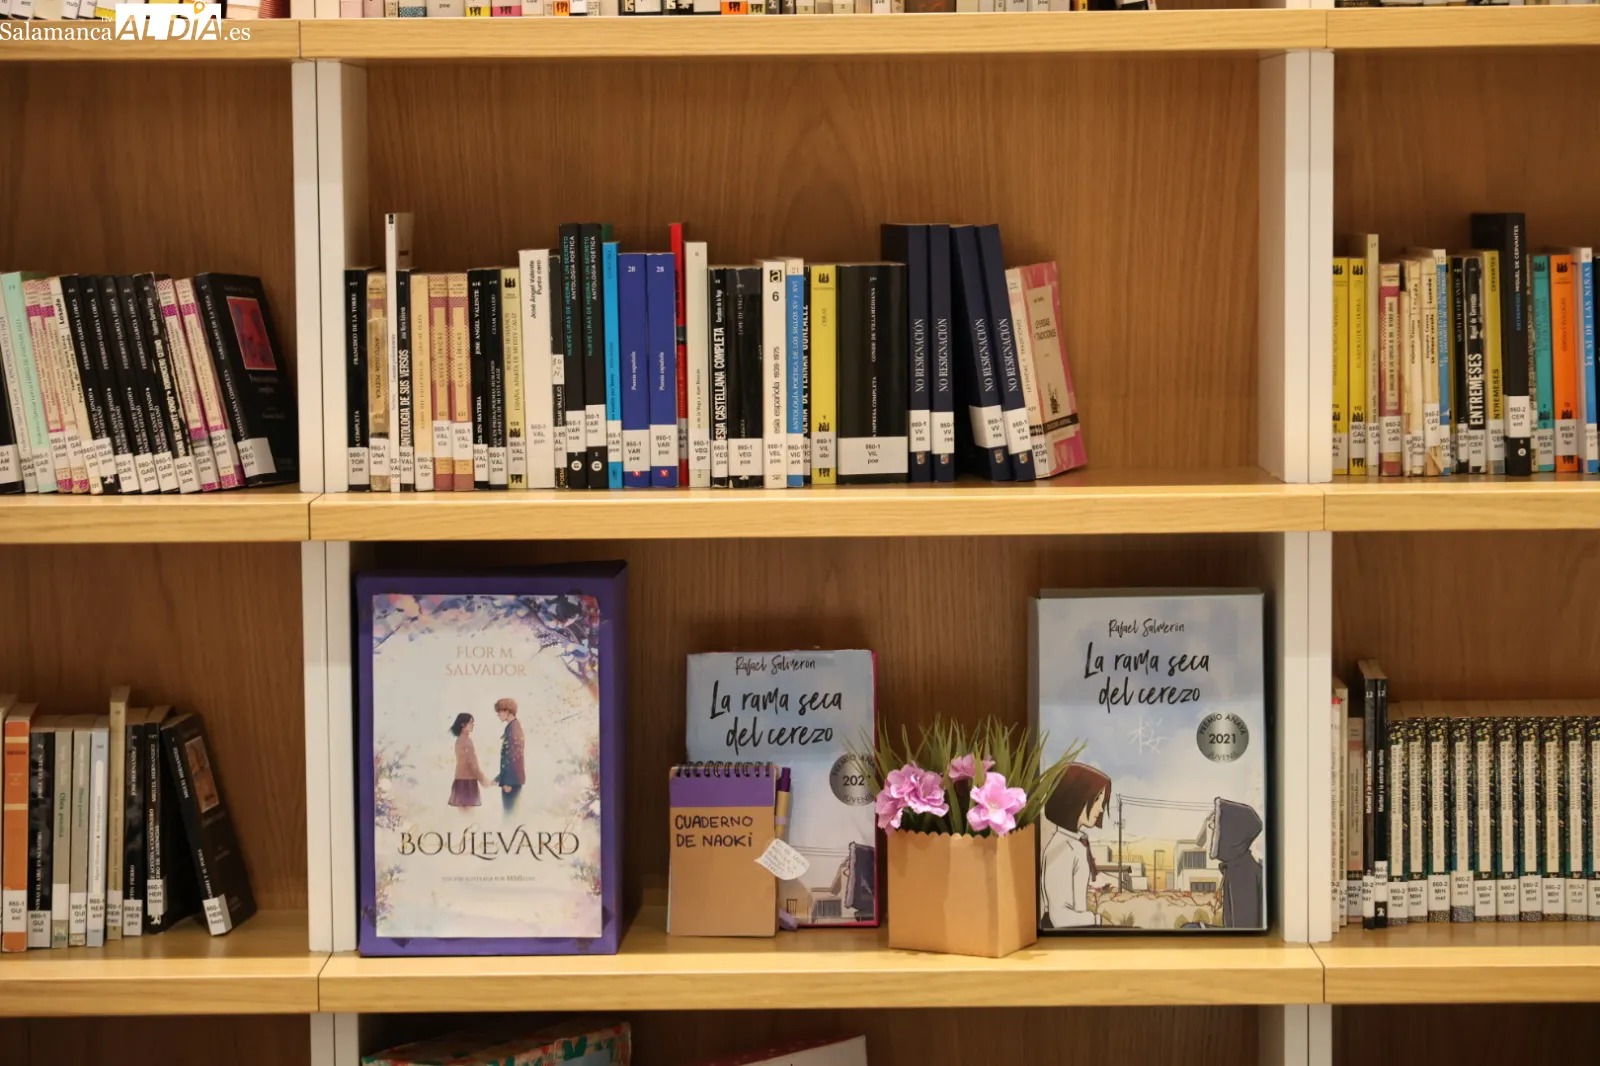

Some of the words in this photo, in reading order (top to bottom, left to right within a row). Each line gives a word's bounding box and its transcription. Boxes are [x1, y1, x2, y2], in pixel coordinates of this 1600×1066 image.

[1514, 260, 1520, 269] DE
[1584, 267, 1592, 296] NIÑAS
[772, 292, 780, 302] 6
[792, 300, 798, 310] XV
[56, 298, 65, 325] Losada
[72, 298, 80, 318] LORCA
[1584, 300, 1592, 318] LAS
[352, 314, 358, 323] LA
[352, 324, 358, 332] DE
[870, 332, 876, 340] DE
[1585, 324, 1592, 336] DE
[80, 341, 90, 370] FEDERICO
[214, 330, 224, 361] GARCILASO
[713, 328, 725, 370] COMPLETA
[792, 350, 798, 360] DE
[913, 318, 925, 377] RESIGNACIÓN
[936, 318, 948, 377] RESIGNACIÓN
[974, 318, 993, 378] RESIGNACIÓN
[998, 318, 1016, 378] RESIGNACIÓN
[399, 349, 410, 378] VERSOS
[223, 369, 236, 400] COMPLETA
[400, 380, 410, 394] SUS
[914, 378, 925, 392] NO
[938, 378, 949, 392] NO
[982, 378, 995, 392] NO
[1007, 378, 1019, 392] NO
[1468, 353, 1484, 425] ENTREMESES
[1492, 368, 1500, 420] NTREMESES
[88, 392, 97, 412] JONDO
[400, 396, 410, 406] DE
[714, 371, 726, 420] CASTELLANA
[772, 382, 782, 416] española
[97, 405, 106, 427] GITANO
[232, 400, 245, 438] CASTELLANA
[791, 391, 799, 430] ANTOLOGÍA
[92, 412, 100, 432] CANTE
[478, 424, 482, 433] EN
[716, 422, 726, 440] ESIA
[628, 448, 640, 456] VAR
[629, 456, 640, 464] poe
[1108, 619, 1138, 638] Rafael
[456, 646, 496, 659] FLOR
[1084, 642, 1104, 678] La
[1114, 650, 1159, 676] rama
[1168, 654, 1210, 676] seca
[445, 664, 527, 676] SALVADOR
[736, 656, 766, 676] Rafael
[710, 680, 731, 720] La
[742, 687, 788, 715] rama
[798, 692, 842, 716] seca
[1098, 676, 1134, 714] del
[1138, 686, 1200, 705] cerezo
[1200, 714, 1222, 735] PREMIO
[1225, 714, 1246, 736] ANAYA
[726, 716, 763, 756] del
[768, 726, 833, 746] cerezo
[1209, 734, 1236, 744] 2021
[173, 746, 184, 778] HERNANDEZ
[181, 779, 189, 798] MIGUEL
[842, 775, 870, 786] 202
[675, 814, 754, 830] CUADERNO
[398, 824, 580, 861] BOULEVARD
[676, 834, 696, 848] DE
